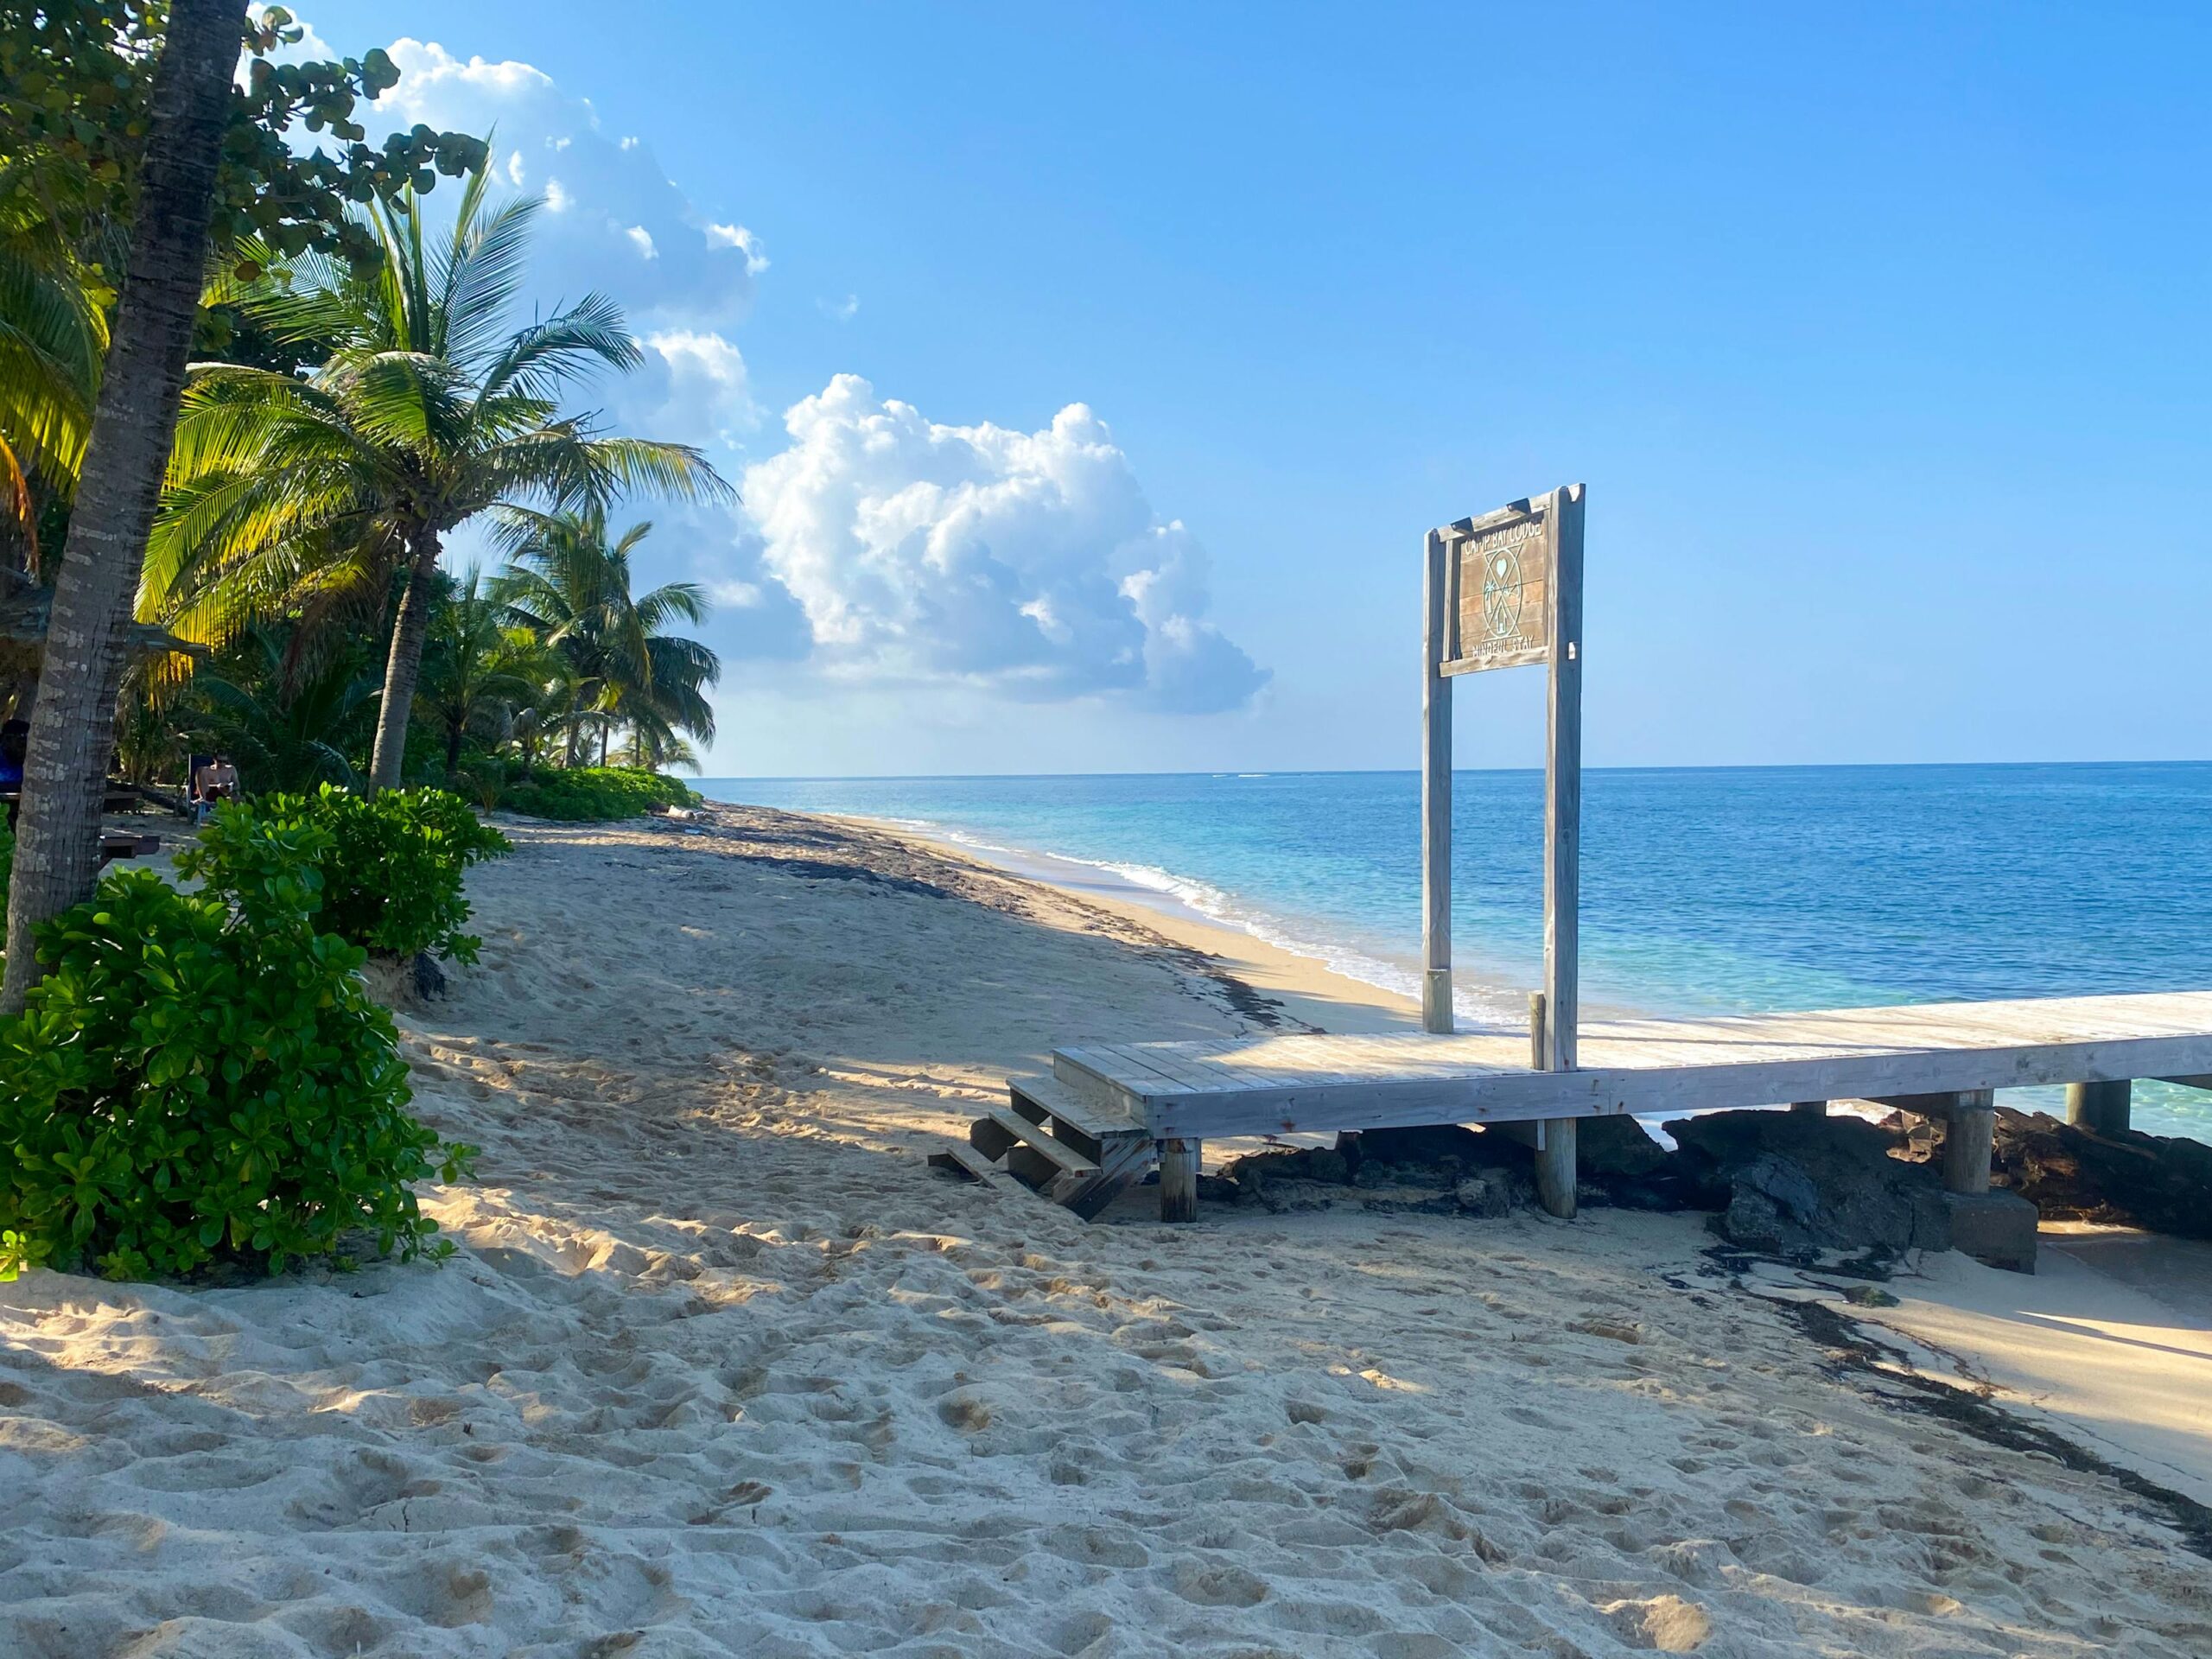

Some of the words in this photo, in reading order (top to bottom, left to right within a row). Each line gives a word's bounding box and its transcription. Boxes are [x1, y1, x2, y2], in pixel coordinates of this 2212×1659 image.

[1465, 533, 1491, 556] CAMP
[1492, 529, 1507, 548] BAY
[1510, 522, 1542, 543] LODGE
[1472, 639, 1508, 658] MINDFUL
[1512, 634, 1535, 652] STAY
